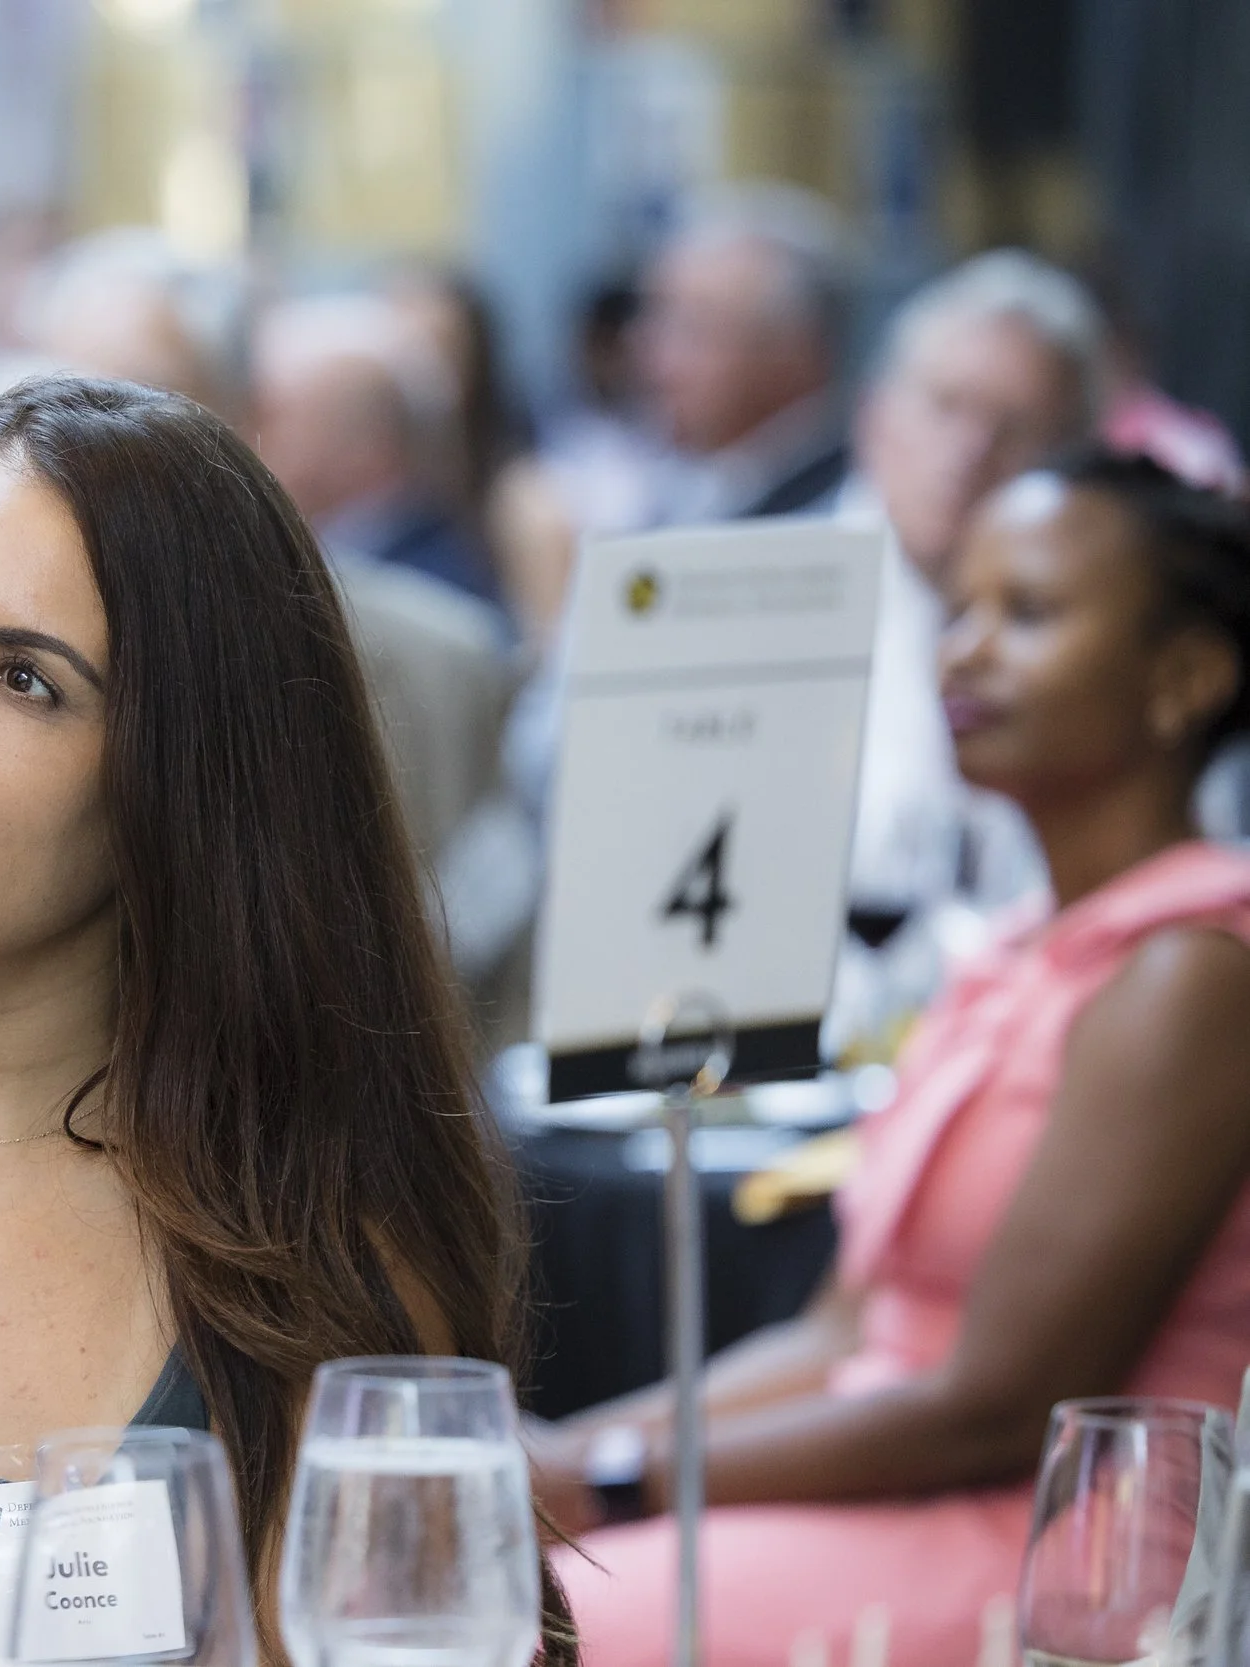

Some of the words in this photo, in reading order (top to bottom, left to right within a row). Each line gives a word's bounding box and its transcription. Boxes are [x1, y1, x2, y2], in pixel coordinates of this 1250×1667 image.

[659, 807, 734, 951] 4
[48, 1551, 108, 1579] Julie
[45, 1591, 118, 1610] Coonce
